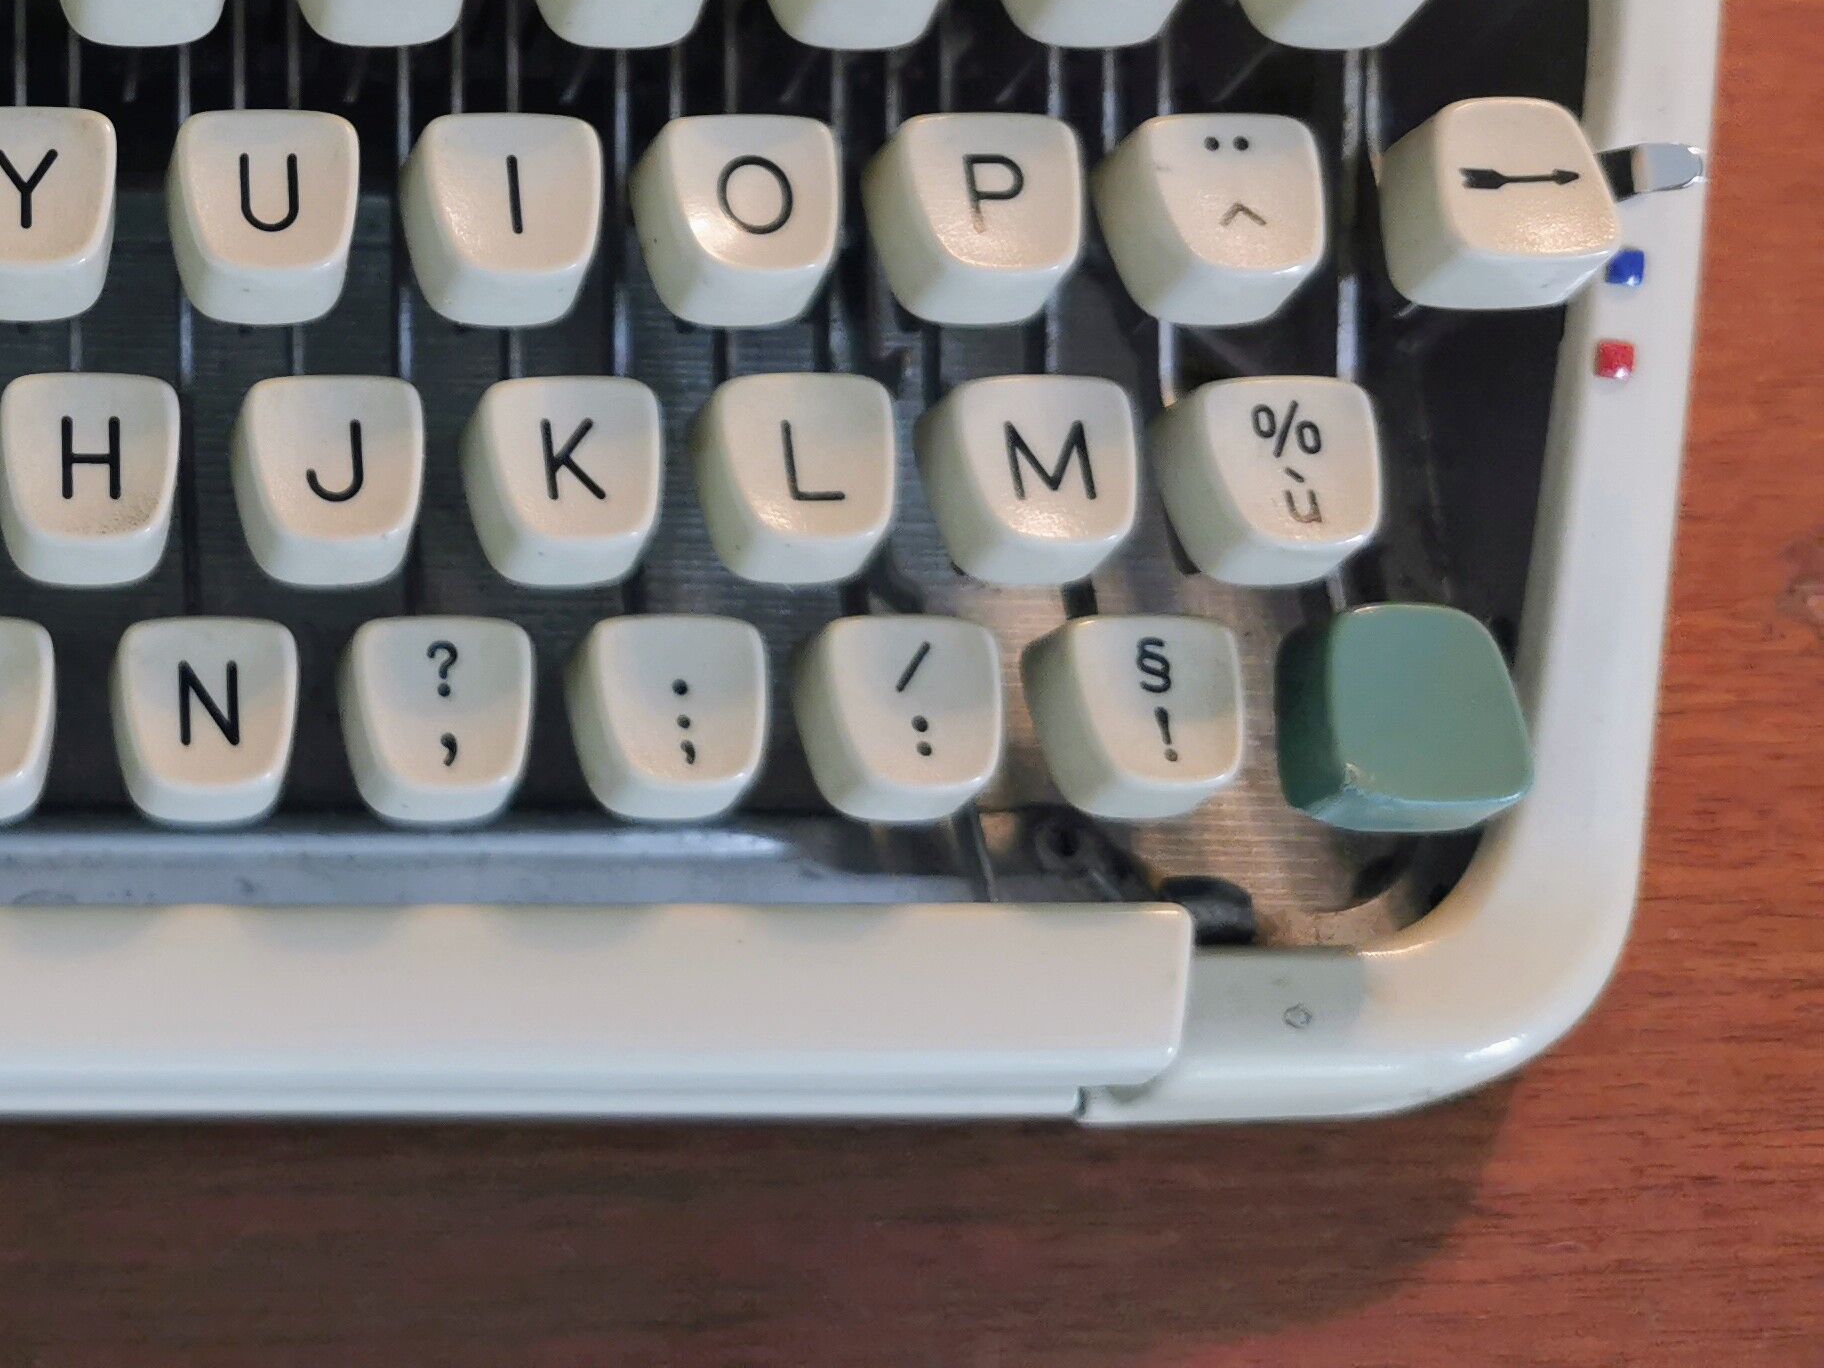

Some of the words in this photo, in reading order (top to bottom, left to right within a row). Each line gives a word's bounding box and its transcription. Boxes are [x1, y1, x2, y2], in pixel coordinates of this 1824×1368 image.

[239, 153, 299, 232] U
[507, 155, 523, 234] I
[718, 156, 793, 235] O
[965, 154, 1024, 232] P
[61, 416, 121, 500] H
[306, 420, 364, 503] J
[541, 419, 606, 500] K
[782, 421, 846, 502] L
[1005, 421, 1097, 500] M
[1253, 401, 1322, 458] %
[1284, 466, 1323, 524] ù
[178, 661, 240, 746] N
[427, 642, 458, 698] ?
[896, 643, 930, 693] /
[1137, 638, 1172, 694] §
[441, 734, 458, 766] ,
[912, 716, 932, 756] :
[1155, 707, 1178, 761] !
